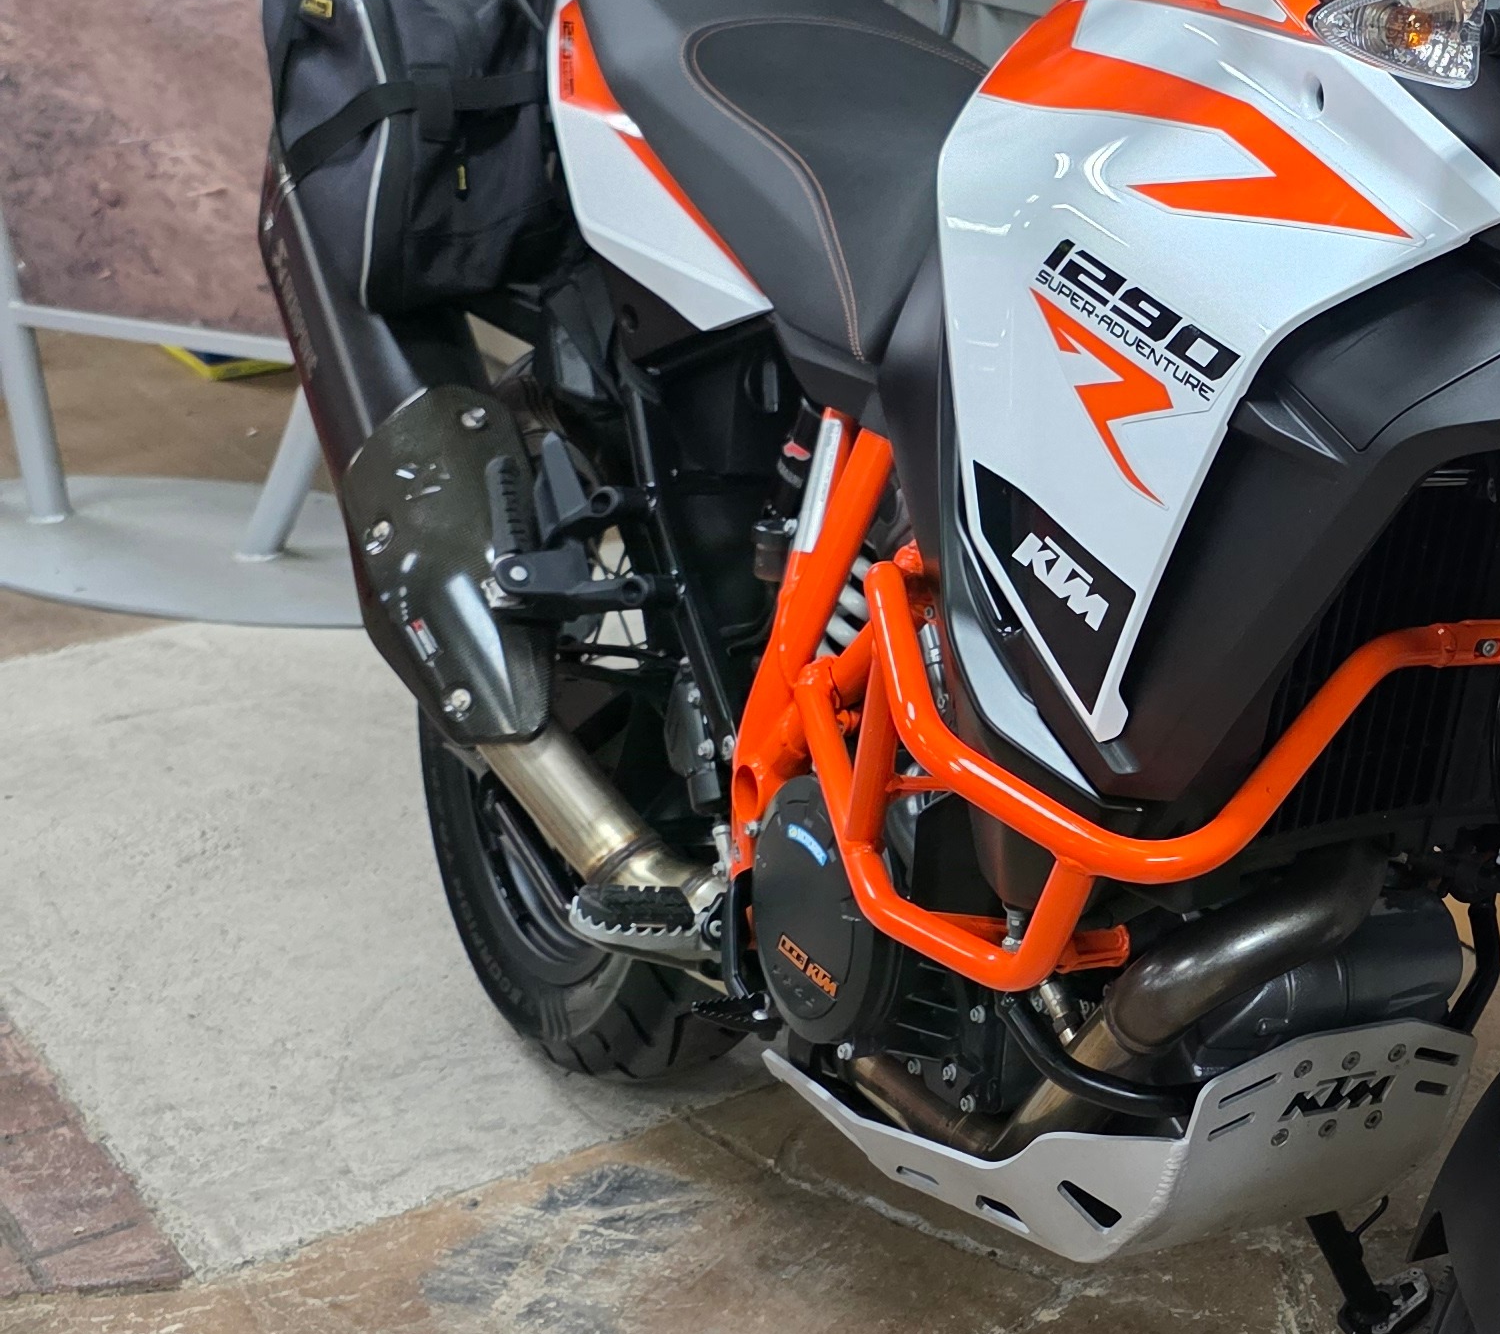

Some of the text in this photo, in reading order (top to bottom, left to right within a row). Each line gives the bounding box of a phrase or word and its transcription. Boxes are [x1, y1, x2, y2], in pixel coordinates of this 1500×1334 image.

[1035, 269, 1216, 402] SUPER-ADVENTURE
[1043, 238, 1242, 381] 1290
[1011, 532, 1110, 632] KTM
[805, 962, 841, 998] KTM
[1277, 1070, 1397, 1123] KTM
